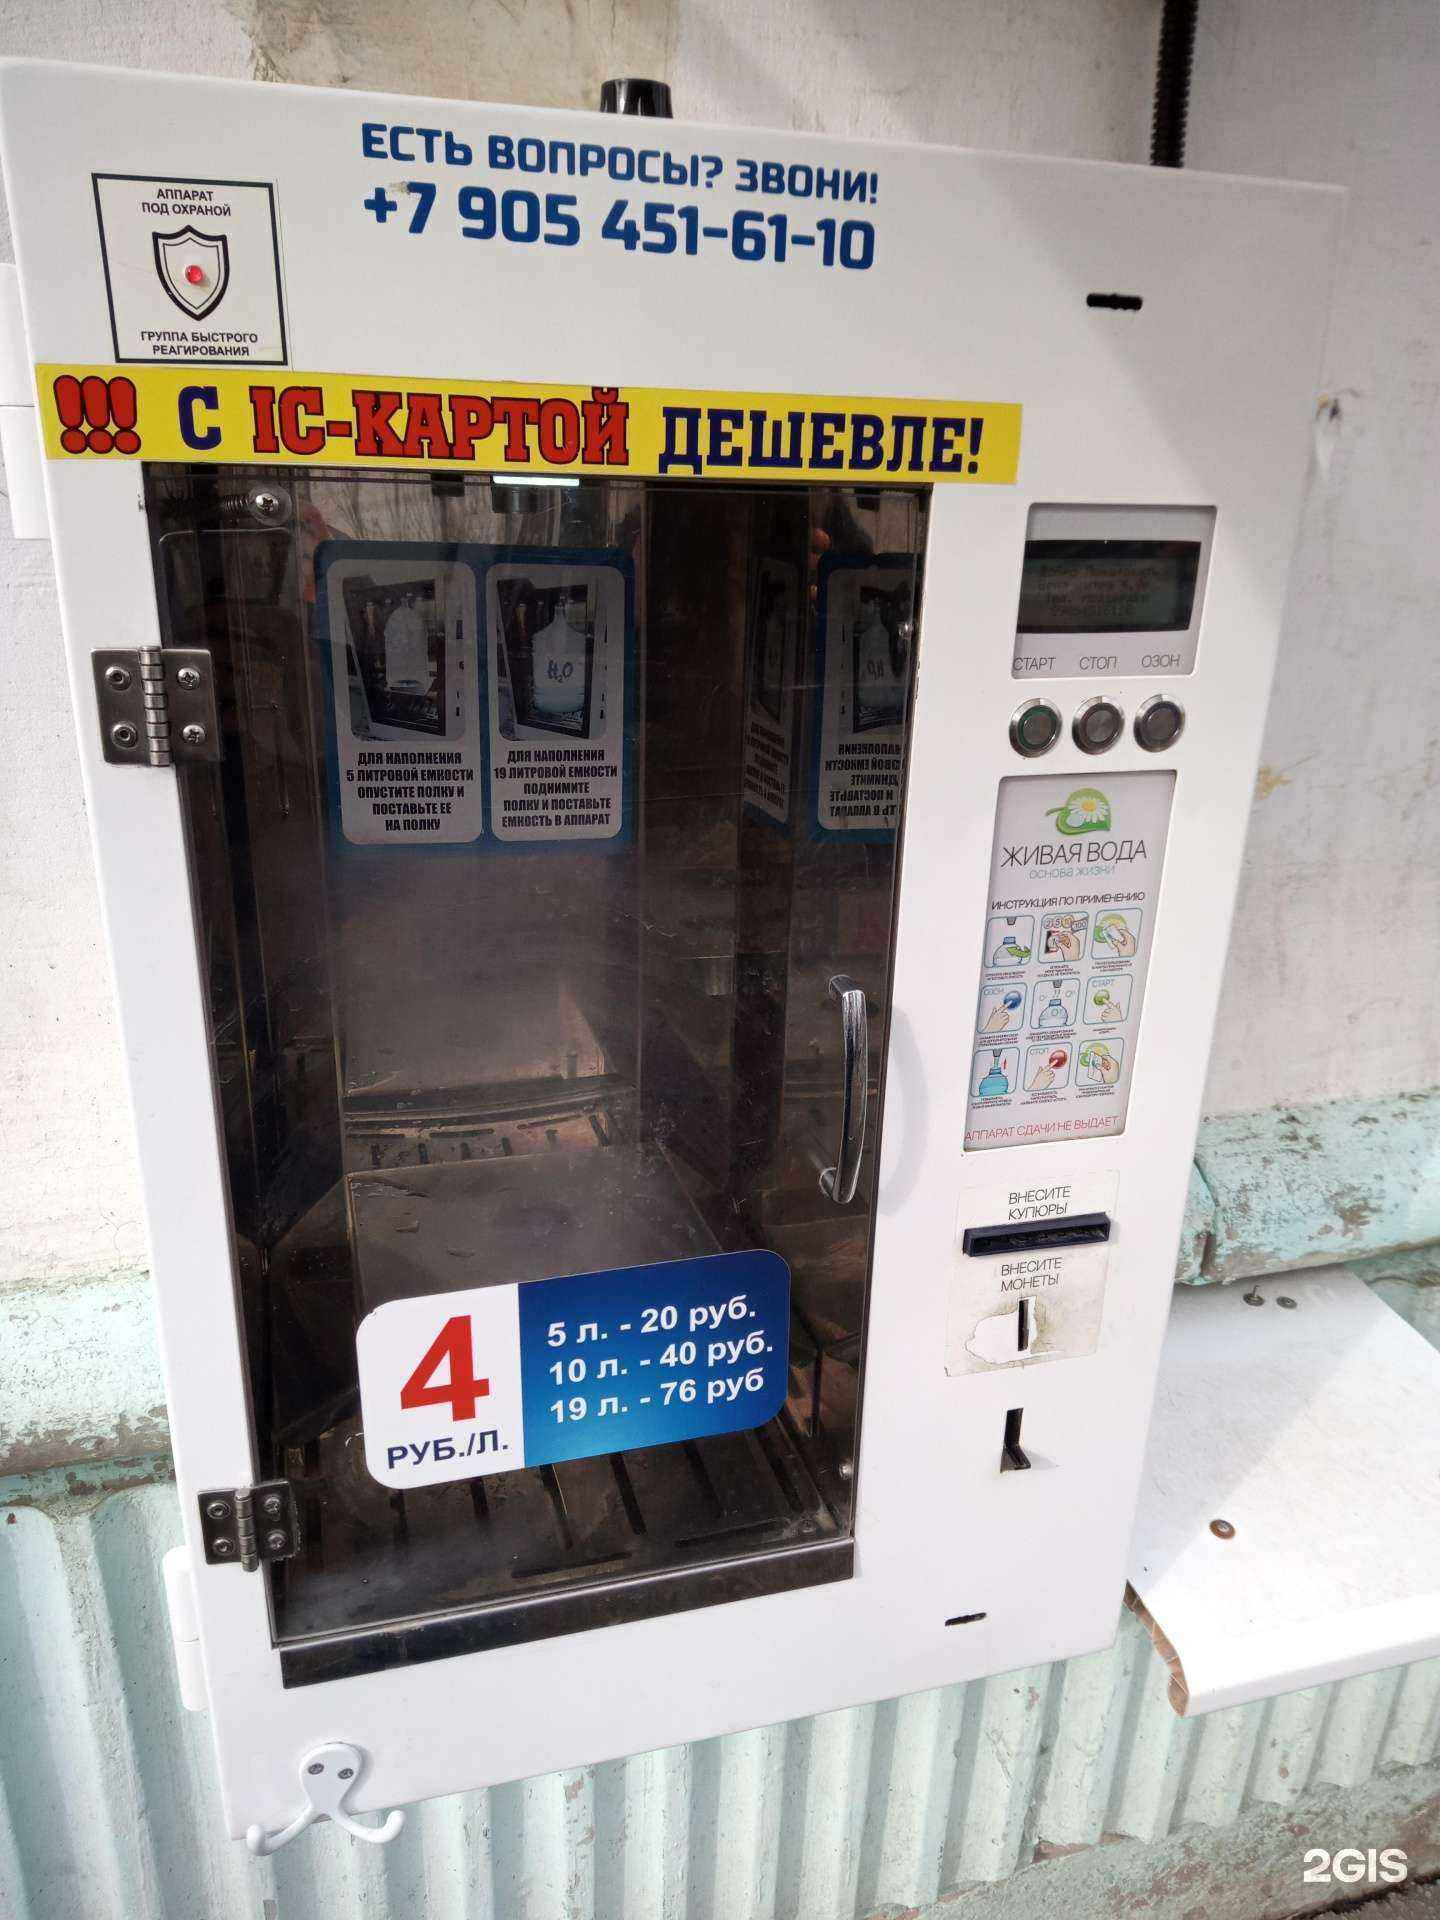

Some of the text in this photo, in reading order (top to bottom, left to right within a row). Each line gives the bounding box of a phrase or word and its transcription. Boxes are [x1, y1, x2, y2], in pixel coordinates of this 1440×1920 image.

[362, 122, 878, 204] ЕСТЬ ВОПРОСЫ? ЗВОНИ!
[157, 188, 213, 201] АППАРАТ
[142, 202, 231, 217] ПОД ОХРАНОЙ
[364, 181, 875, 269] +7 905 451-61-10
[141, 331, 258, 343] ГРУППА БЫСТРОГО
[152, 344, 249, 357] РЕАГИРОВАНИЯ
[178, 385, 222, 450] С
[658, 406, 984, 475] ДЕШЕВЛЕ!
[1013, 654, 1181, 671] СТАРТ СТОП ОЗОН
[358, 752, 461, 766] ДЛЯ НАПОЛНЕНИЯ
[507, 750, 605, 764] ДЛЯ НАПОЛНЕНИЯ
[346, 767, 474, 782] 5 ЛИТРОВОЙ ЕМКОСТИ
[494, 765, 617, 779] 19 ЛИТРОВОЙ ЕМКОСТИ
[357, 786, 464, 799] ОПУСТИТЕ ПОЛКУ И
[524, 782, 590, 796] ПОДНИМИТЕ
[372, 802, 452, 815] ПОСТАВЬТЕ ЕЕ
[504, 797, 612, 812] ПОЛКУ И ПОСТАВЬТЕ
[385, 819, 440, 831] НА ПОЛКУ
[502, 813, 611, 828] ЕМКОСТЬ В АППАРАТ
[1001, 840, 1147, 867] ЖИВАЯ ВОДА
[991, 892, 1145, 911] ИНСТРУКЦИЯ ПО ПРИМЕНЕНИЮ
[964, 1116, 1119, 1142] АППАРАТ СДАЧИ НЕ ВЫДАЕТ
[1008, 1186, 1071, 1205] ВНЕСИТЕ
[1008, 1202, 1068, 1220] КУПЮРЫ
[1001, 1257, 1062, 1276] ВНЕСИТЕ
[1000, 1274, 1060, 1292] МОНЕТЫ
[547, 1321, 566, 1347] 5
[576, 1321, 608, 1342] л.
[640, 1306, 678, 1334] 20
[689, 1294, 756, 1332] руб.
[549, 1358, 586, 1385] 10
[596, 1356, 628, 1379] л.
[660, 1341, 697, 1368] 40
[707, 1330, 773, 1367] руб.
[400, 1315, 490, 1422] 4
[550, 1398, 587, 1424] 19
[597, 1397, 628, 1418] л.
[660, 1379, 697, 1407] 76
[707, 1368, 763, 1404] руб
[387, 1429, 508, 1469] РУБ./Л.
